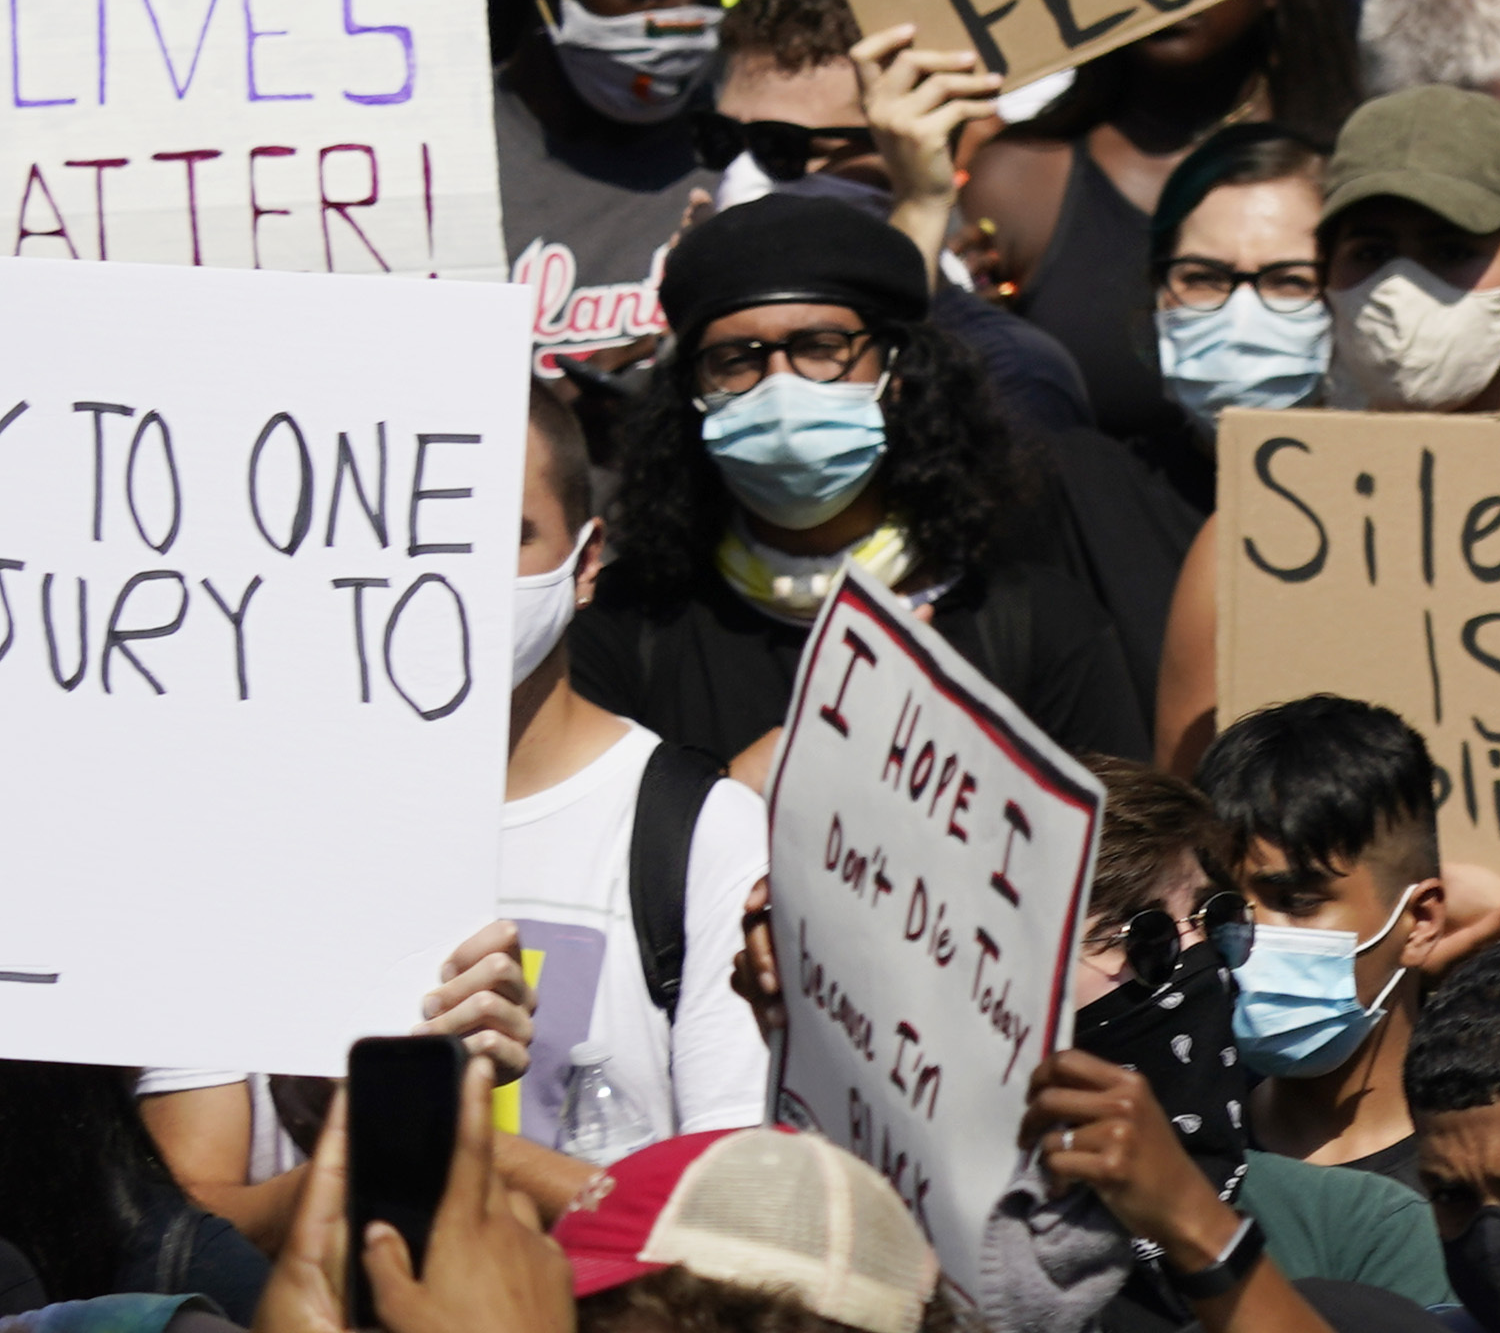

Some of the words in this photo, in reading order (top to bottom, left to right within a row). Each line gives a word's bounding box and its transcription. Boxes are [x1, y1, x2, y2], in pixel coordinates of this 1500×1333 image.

[14, 143, 440, 281] ATTER!
[73, 400, 181, 553] TO
[249, 411, 484, 558] ONE
[332, 572, 472, 722] TO
[819, 625, 878, 739] I
[882, 688, 978, 846] HOPE
[989, 798, 1034, 910] I
[904, 874, 957, 968] Die
[973, 923, 1032, 1087] Today
